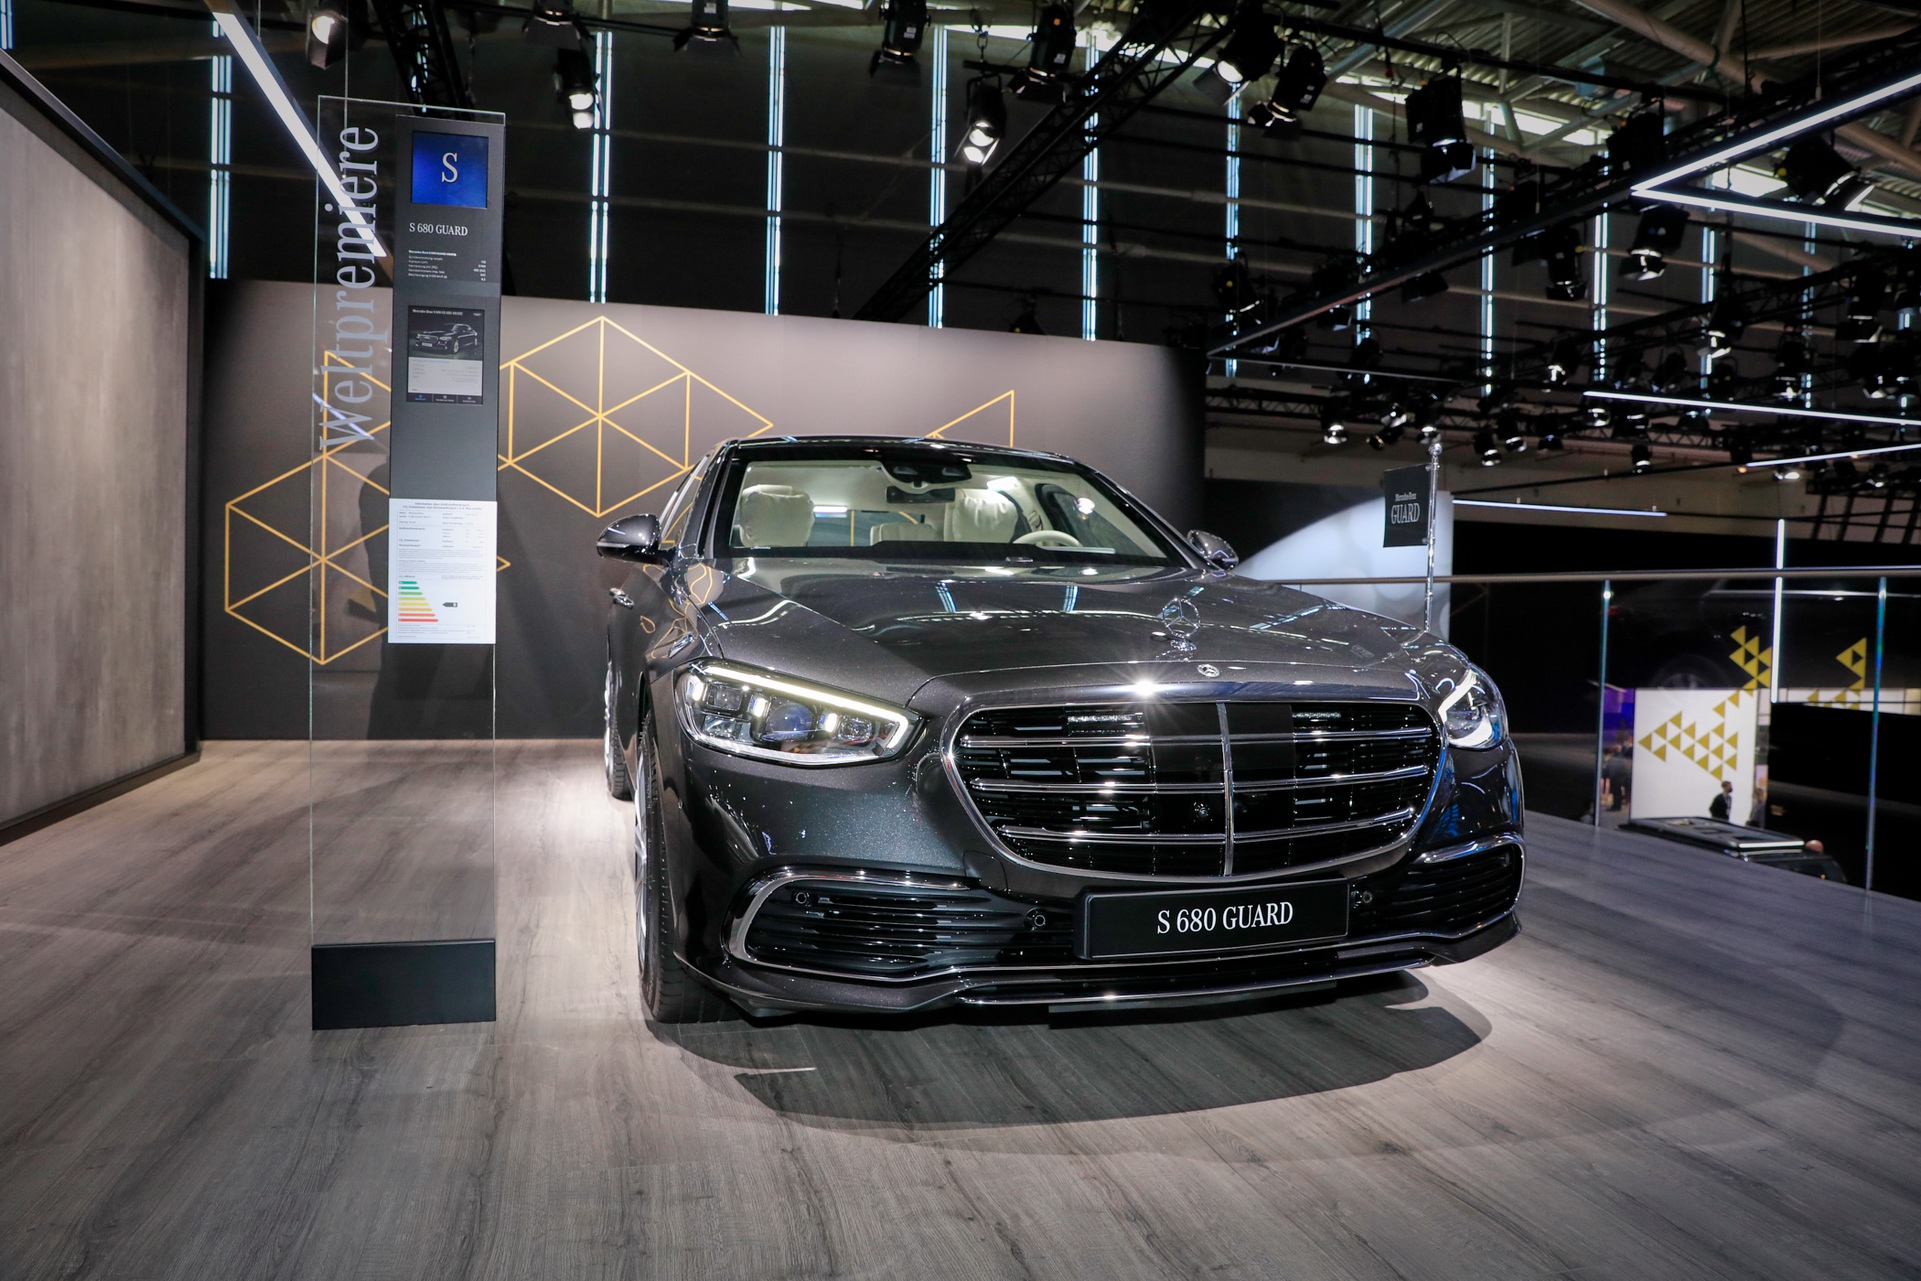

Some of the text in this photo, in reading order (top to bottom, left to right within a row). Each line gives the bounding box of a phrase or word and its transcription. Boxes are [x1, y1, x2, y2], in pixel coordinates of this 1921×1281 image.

[441, 152, 459, 183] S
[409, 222, 468, 236] S 680 GUARD
[319, 126, 390, 450] Weltpremiere
[1391, 503, 1420, 524] GUARD
[1157, 901, 1294, 935] S 680 GUARD
